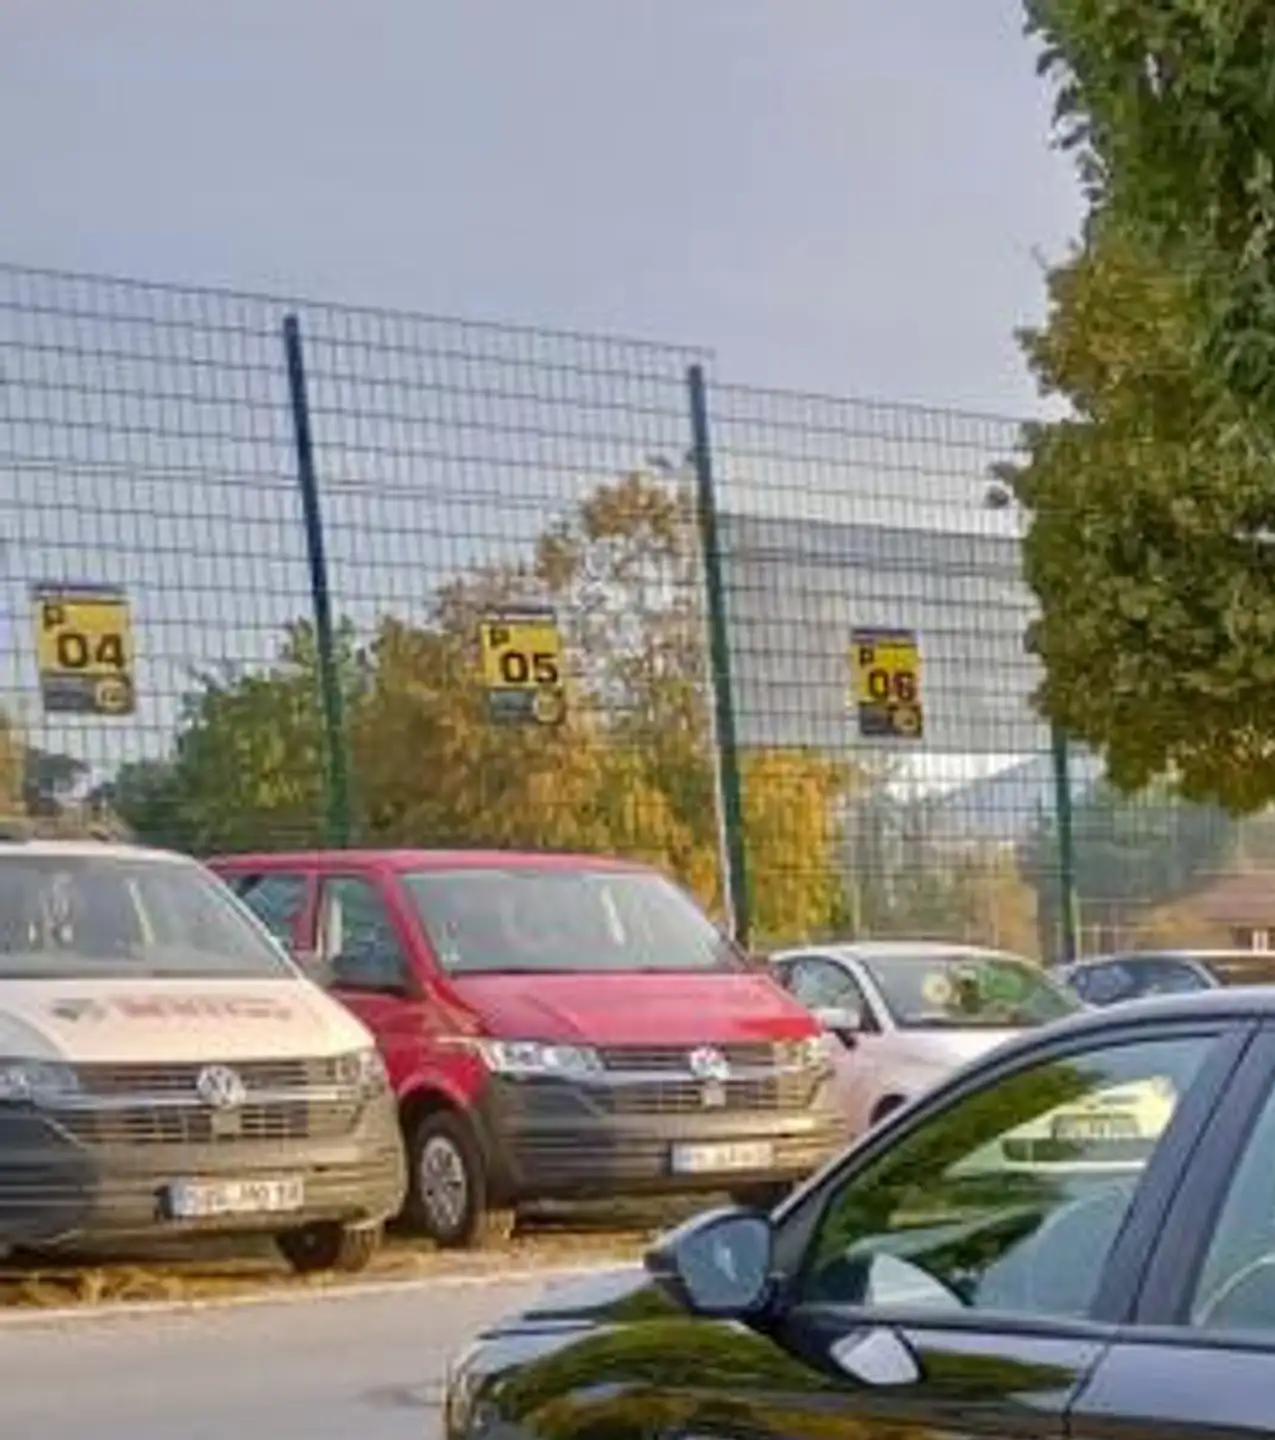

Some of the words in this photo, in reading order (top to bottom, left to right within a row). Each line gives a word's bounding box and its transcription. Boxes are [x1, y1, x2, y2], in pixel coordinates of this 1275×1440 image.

[42, 603, 64, 630] P
[57, 633, 125, 669] 04
[501, 652, 558, 683] 05
[868, 669, 915, 702] 06
